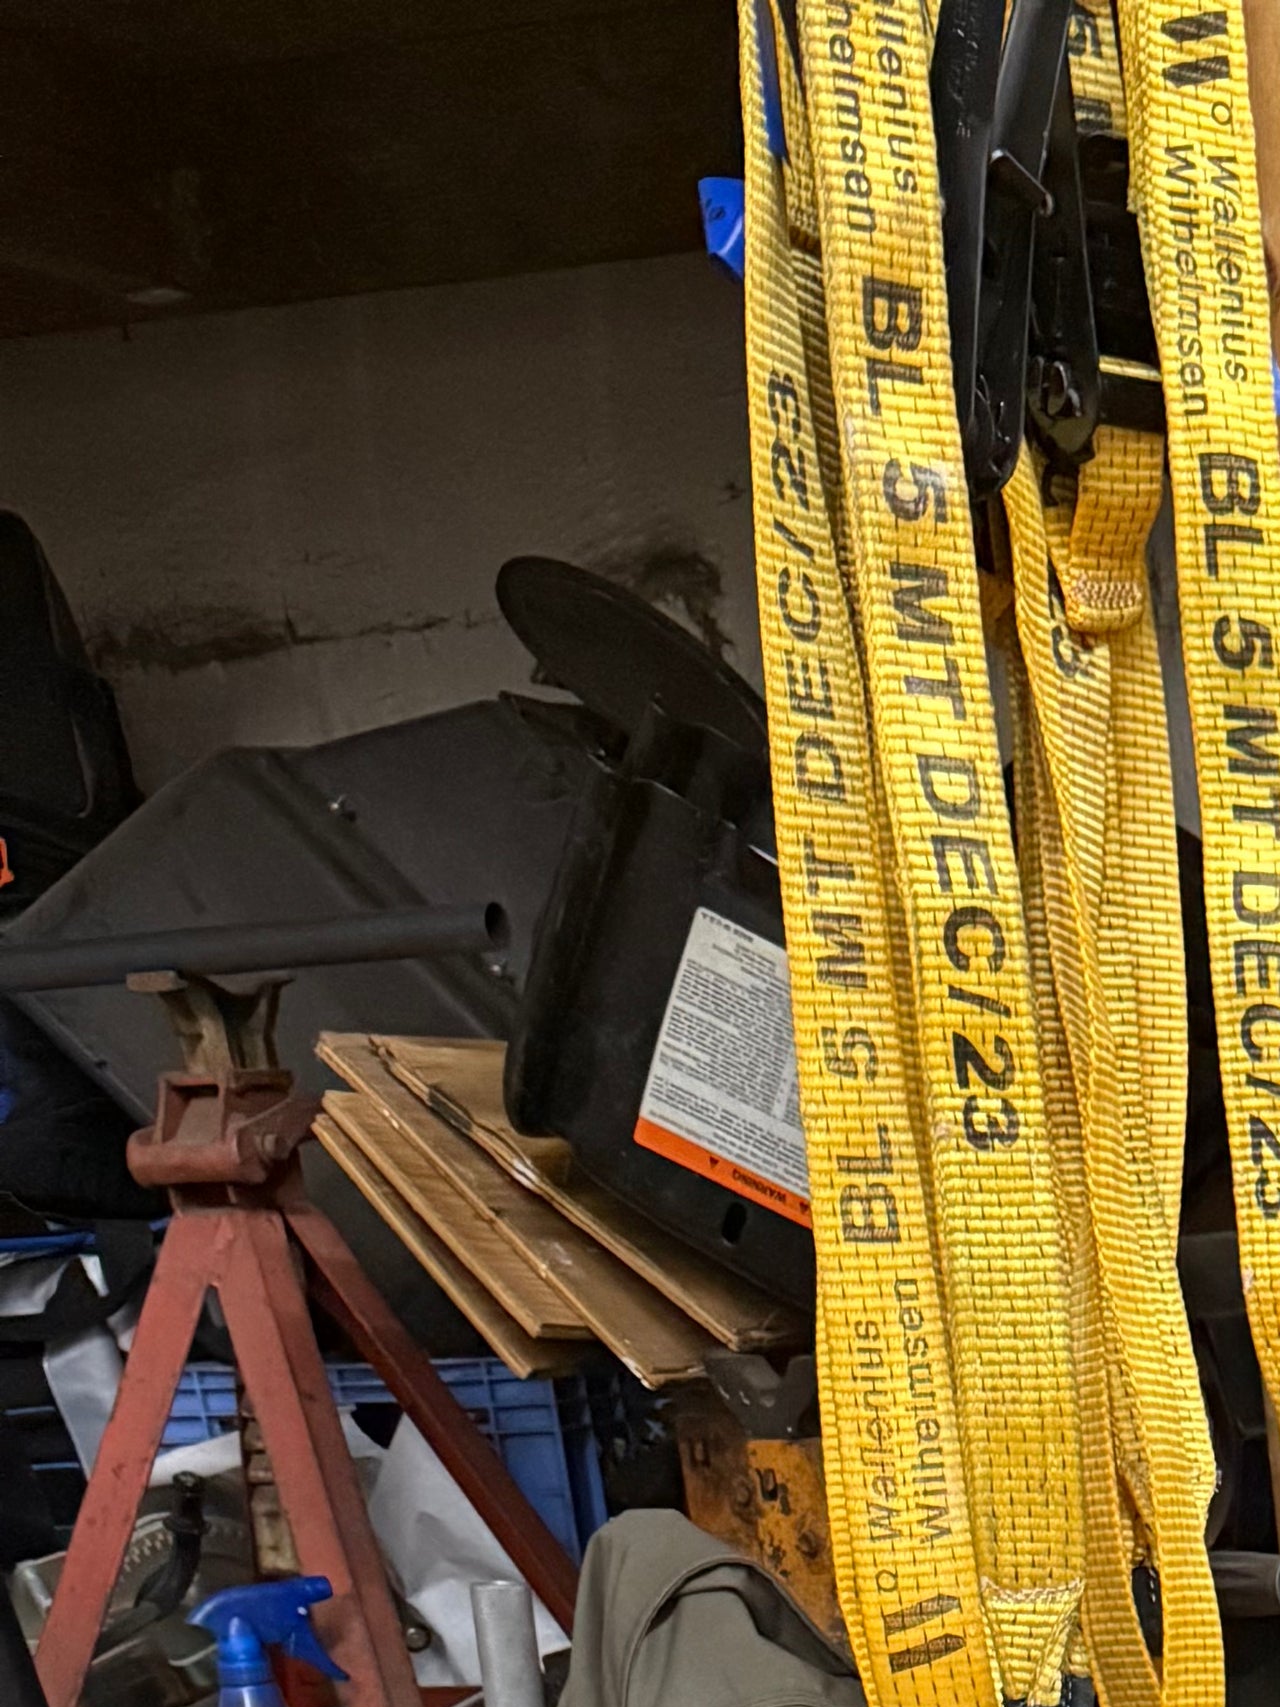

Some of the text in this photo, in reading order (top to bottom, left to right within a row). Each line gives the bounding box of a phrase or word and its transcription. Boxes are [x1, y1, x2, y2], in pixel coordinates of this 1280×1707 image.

[873, 0, 919, 194] llenius
[1163, 143, 1207, 418] Wilhelmsen
[1207, 155, 1248, 384] Wallenius
[1199, 453, 1260, 577] BL
[862, 276, 1022, 1153] BL 5 MT DEC/23
[1213, 614, 1274, 671] 5
[768, 369, 902, 1246] BL 5 MT DEC/23
[854, 1318, 900, 1543] Wallenius
[893, 1277, 952, 1545] Wilhelmsen
